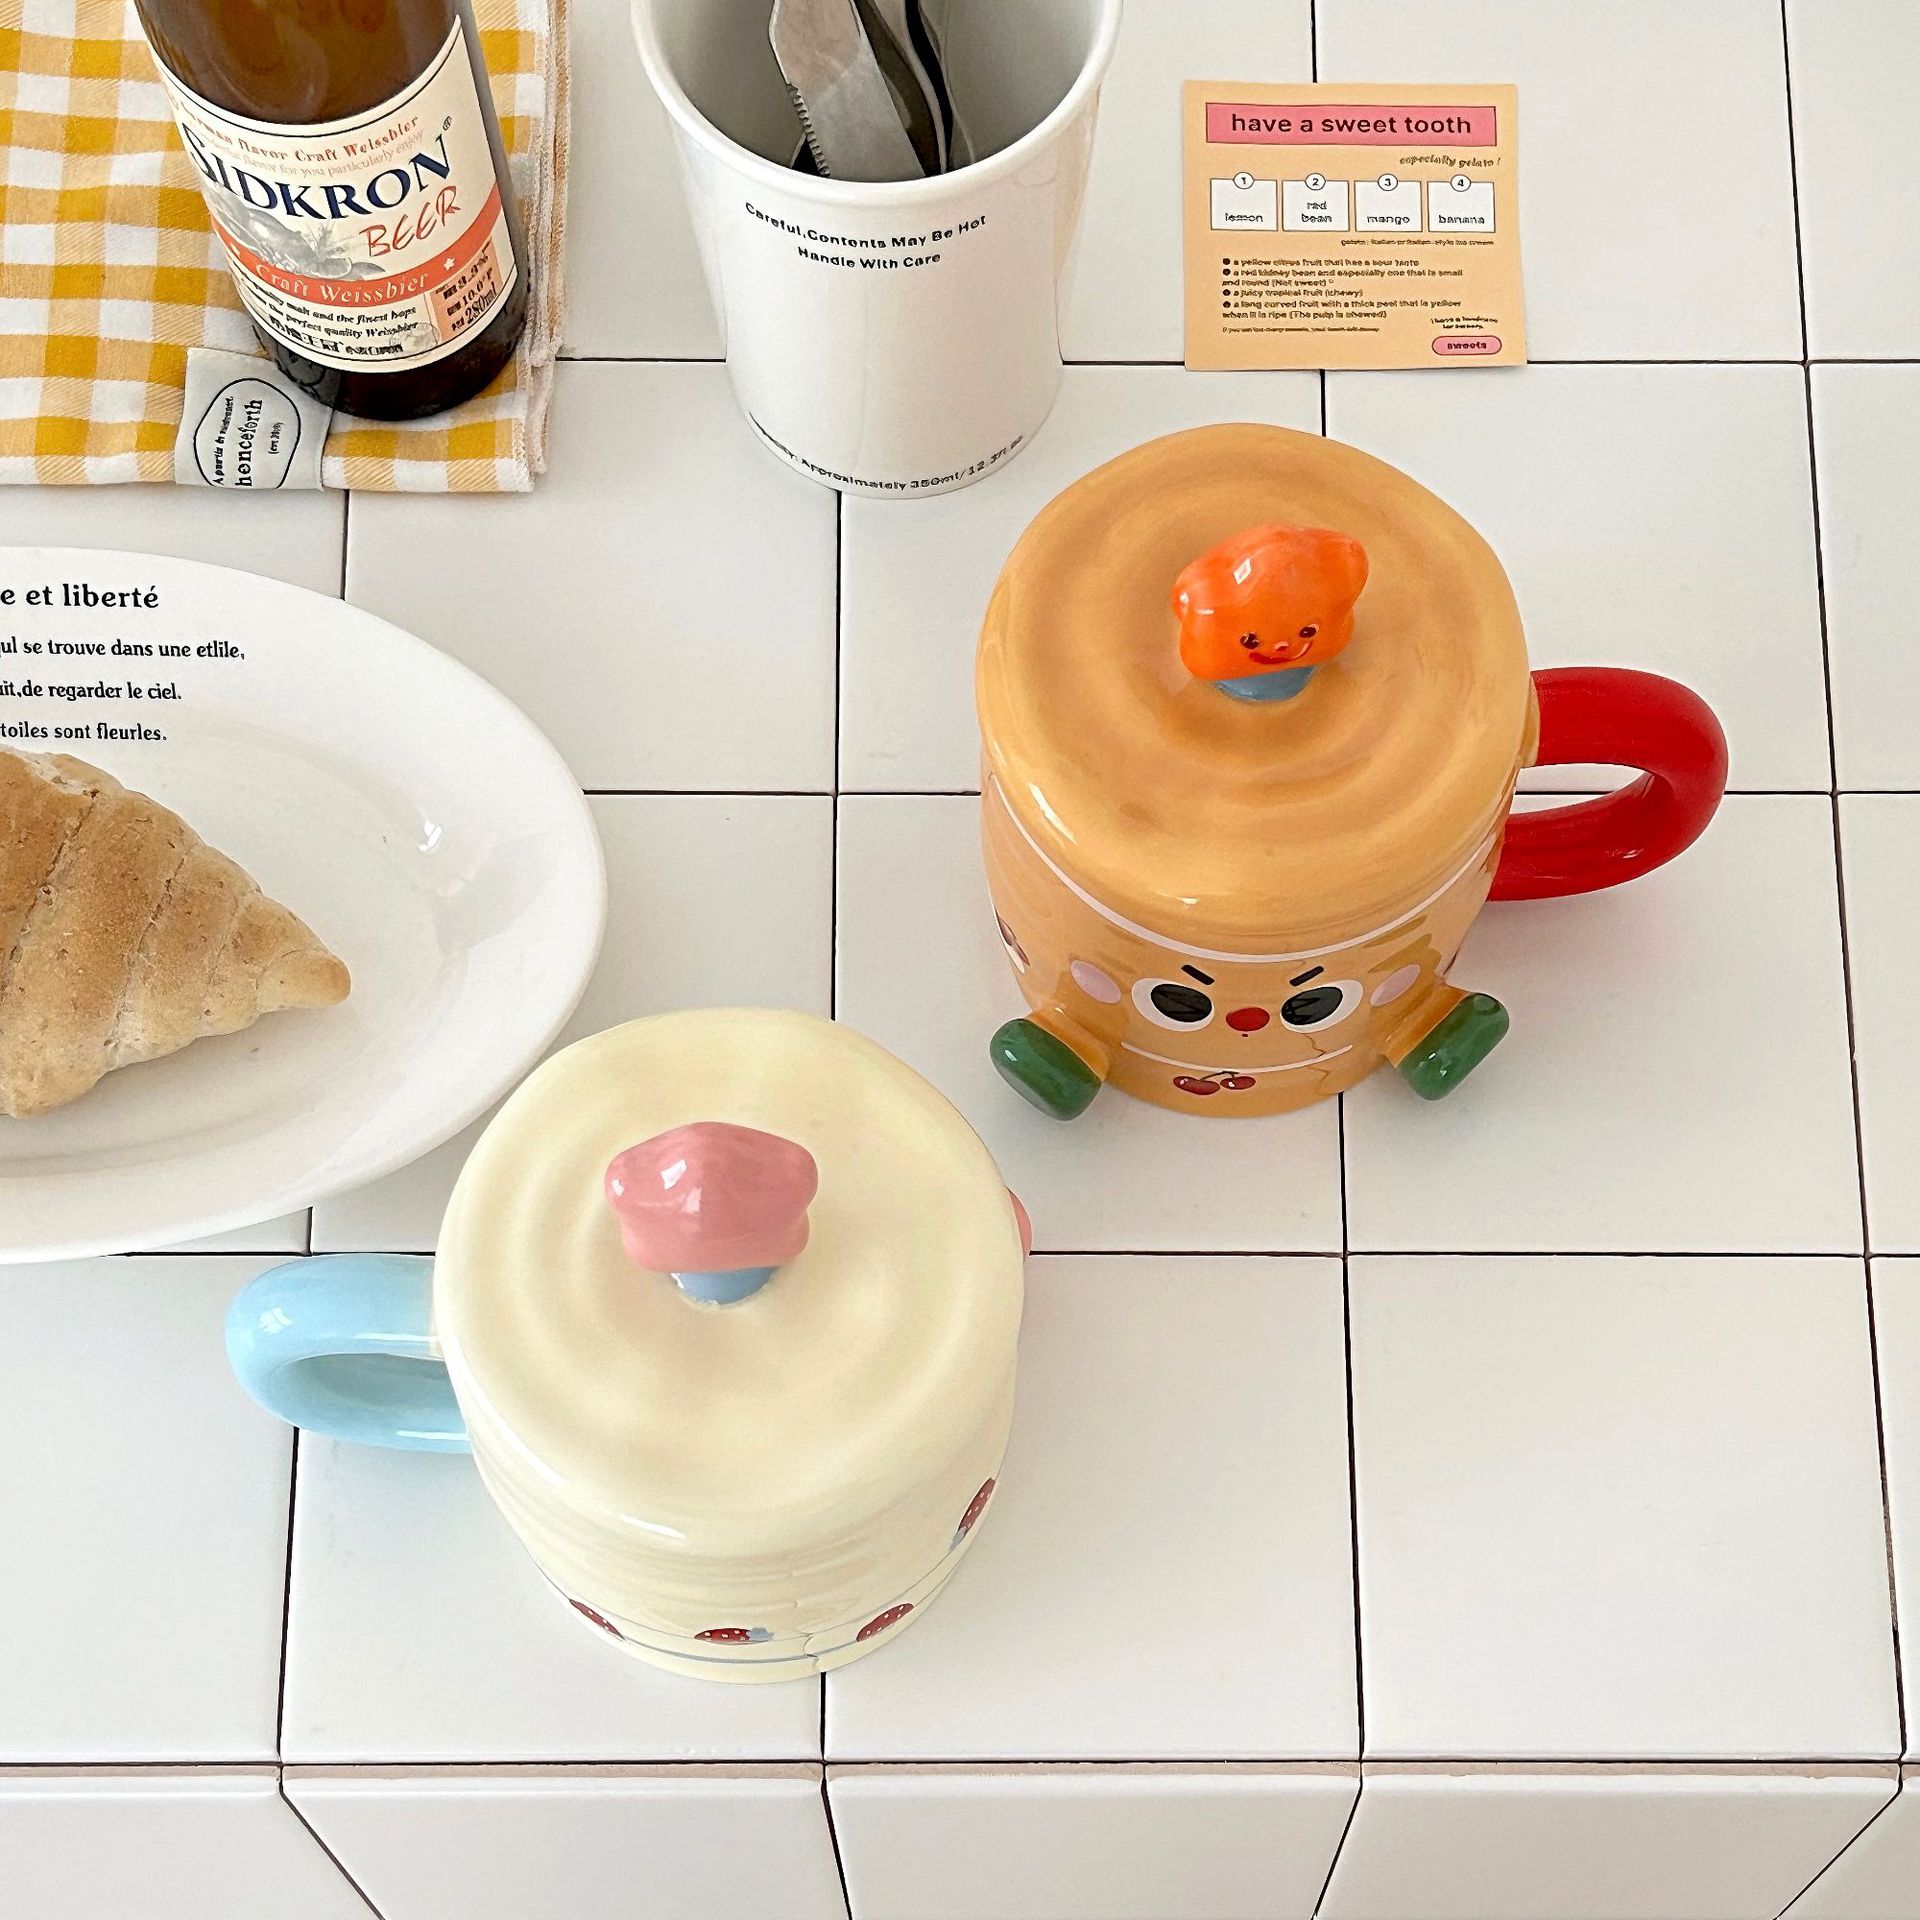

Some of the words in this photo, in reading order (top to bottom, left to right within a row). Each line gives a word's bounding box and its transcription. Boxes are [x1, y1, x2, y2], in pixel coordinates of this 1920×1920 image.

[1232, 114, 1292, 133] have
[1300, 118, 1314, 133] a
[1321, 116, 1396, 134] sweet
[1404, 116, 1472, 134] tooth
[182, 122, 451, 220] SIDKRON
[359, 185, 462, 257] BEER
[891, 234, 927, 248] May
[958, 215, 987, 235] Hot
[1367, 214, 1410, 226] mango
[797, 246, 856, 269] Handle
[859, 258, 899, 270] With
[902, 253, 942, 269] Care
[256, 263, 309, 297] Craft
[320, 272, 428, 303] Weissbier
[26, 585, 54, 606] et
[62, 583, 160, 609] liberté
[23, 642, 43, 655] se
[48, 639, 107, 656] trouve
[110, 638, 154, 657] dans
[158, 644, 192, 657] une
[48, 680, 123, 702] regarder
[127, 681, 143, 699] le
[147, 682, 182, 700] ciel.
[54, 724, 92, 740] sont
